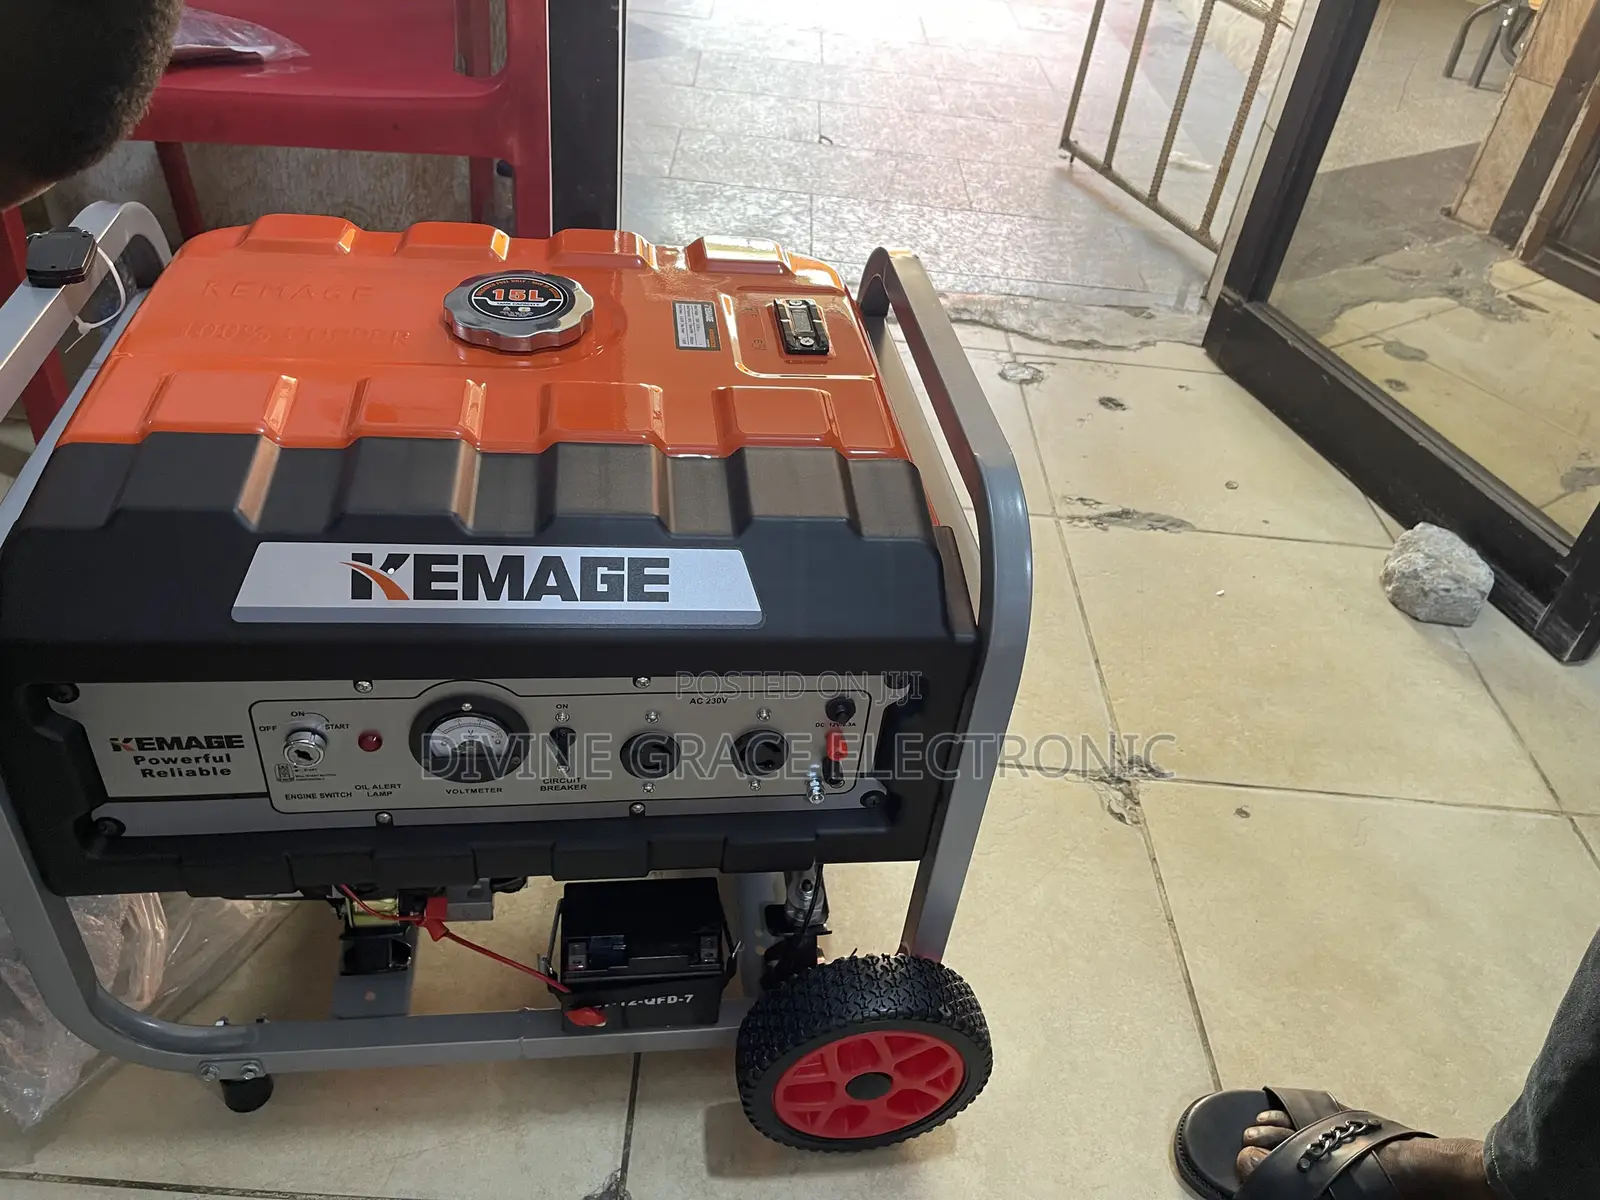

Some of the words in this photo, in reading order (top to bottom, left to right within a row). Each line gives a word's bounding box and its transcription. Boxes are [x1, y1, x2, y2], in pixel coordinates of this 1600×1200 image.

[492, 288, 544, 301] 15L
[339, 553, 670, 602] KEMAGE
[689, 697, 704, 705] AC
[705, 697, 728, 705] 230V
[325, 723, 350, 731] START
[109, 735, 245, 752] KEMAGE
[133, 753, 232, 765] Powerful
[140, 766, 232, 778] Reliable
[543, 777, 582, 785] CIRCUIT
[445, 787, 503, 795] VOLTMETER
[540, 784, 587, 792] BREAKER
[285, 792, 318, 801] ENGINE
[319, 791, 352, 799] SWITCH
[366, 790, 393, 798] LAMP
